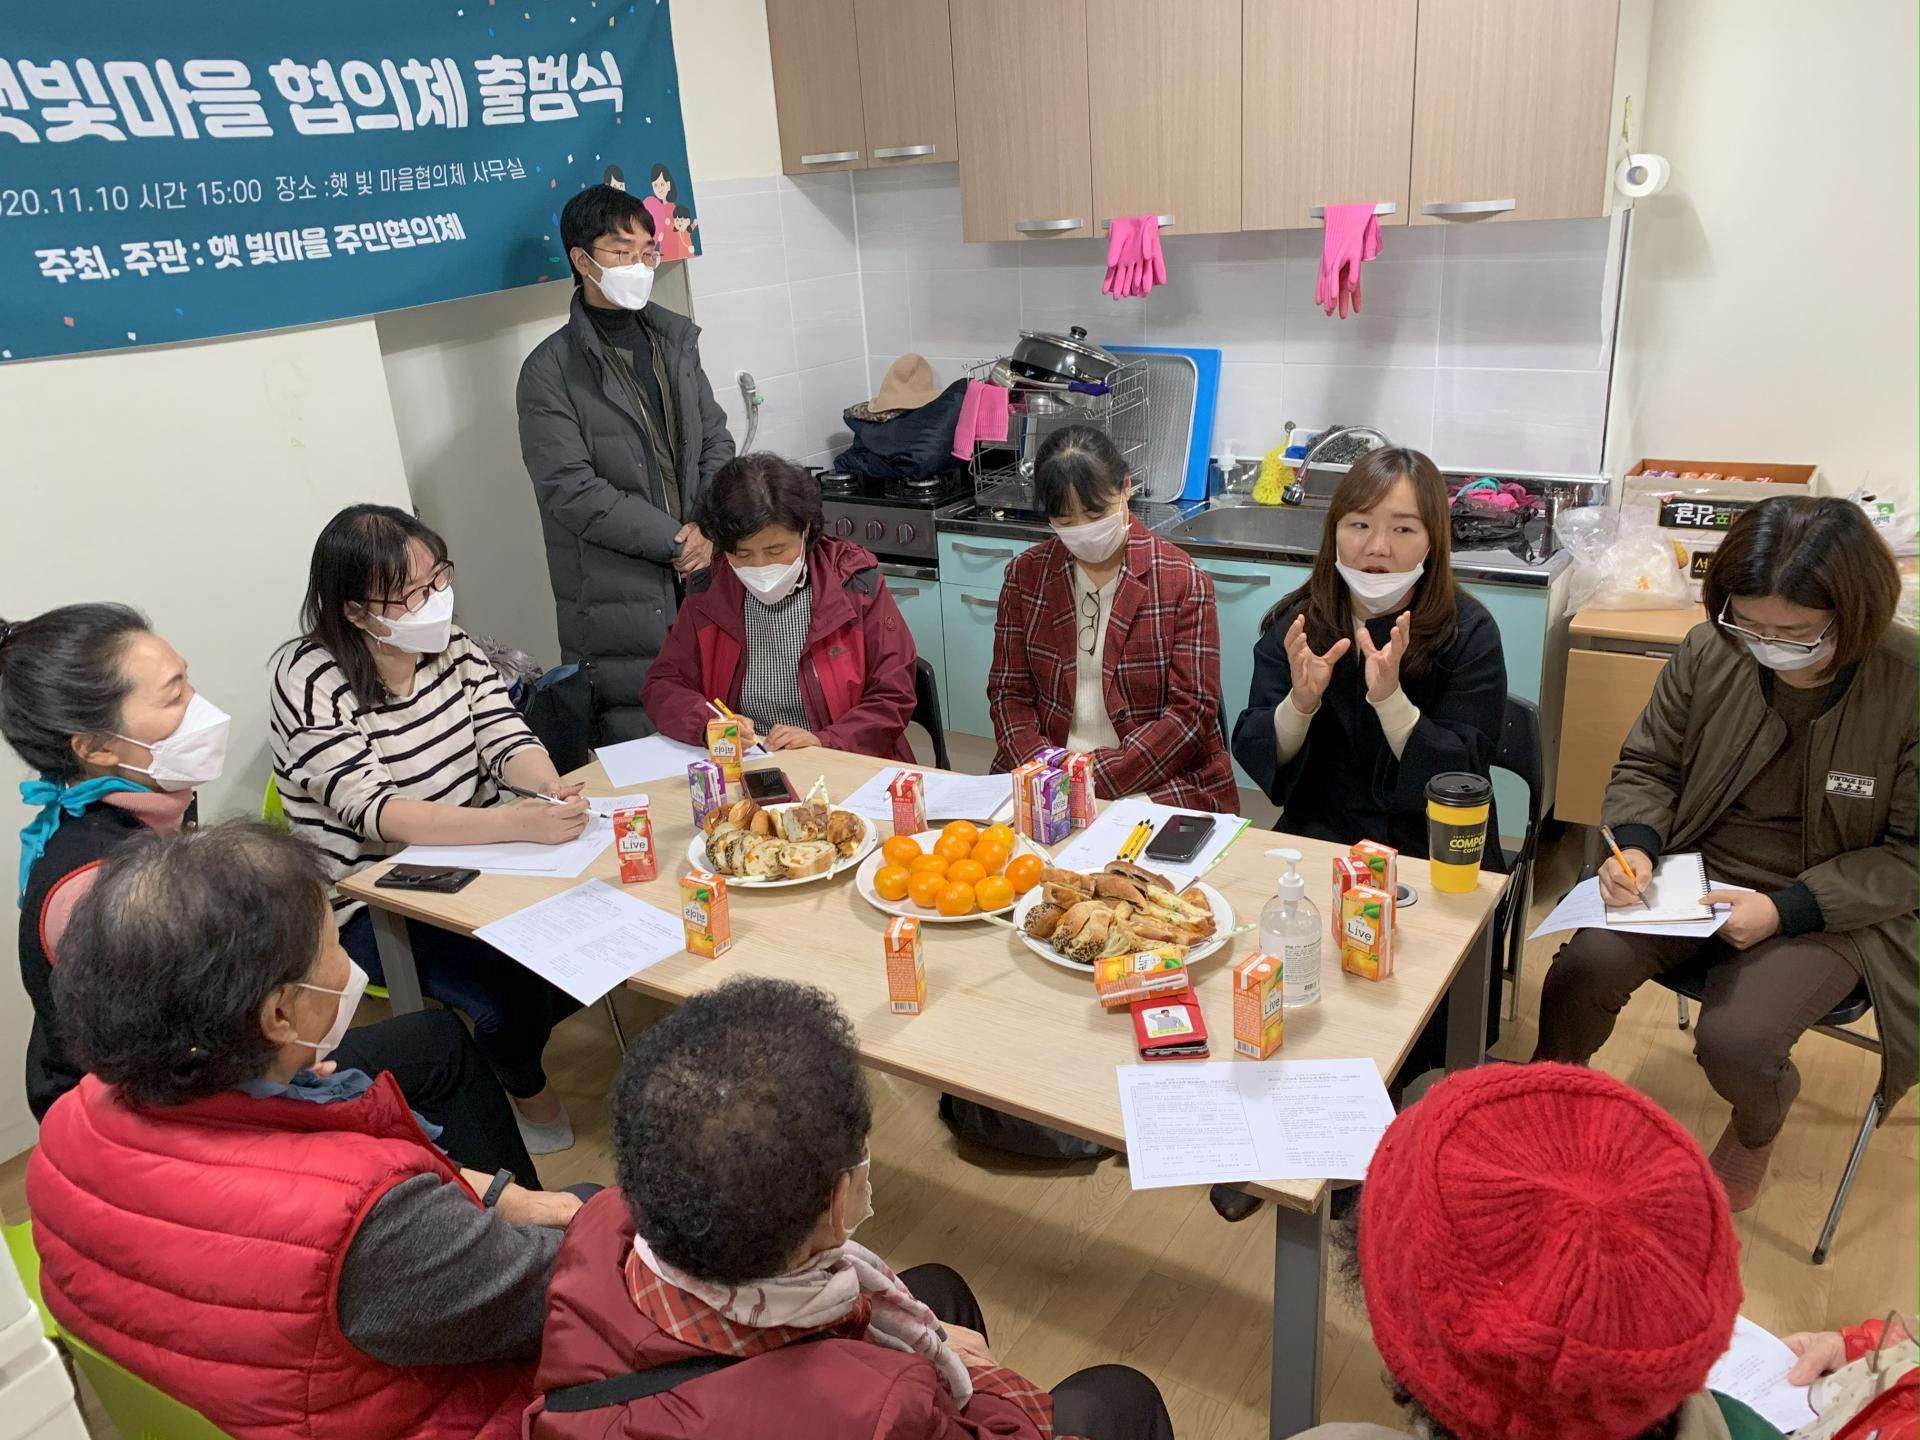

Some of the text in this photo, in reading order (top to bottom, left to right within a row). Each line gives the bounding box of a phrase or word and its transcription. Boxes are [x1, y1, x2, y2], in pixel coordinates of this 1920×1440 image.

[268, 57, 469, 136] 협의체
[474, 50, 624, 126] 출범식
[0, 185, 129, 217] 20.11.10
[139, 181, 188, 210] 시간
[196, 179, 263, 206] 15:00
[275, 175, 317, 203] 장소
[355, 170, 374, 197] 빛
[380, 162, 467, 193] 마을협의체
[473, 157, 528, 184] 사무실
[245, 226, 332, 265] 빛마을
[333, 212, 467, 256] 주민협의체
[622, 841, 646, 850] Live
[1347, 922, 1373, 942] Live
[1264, 998, 1281, 1016] Live
